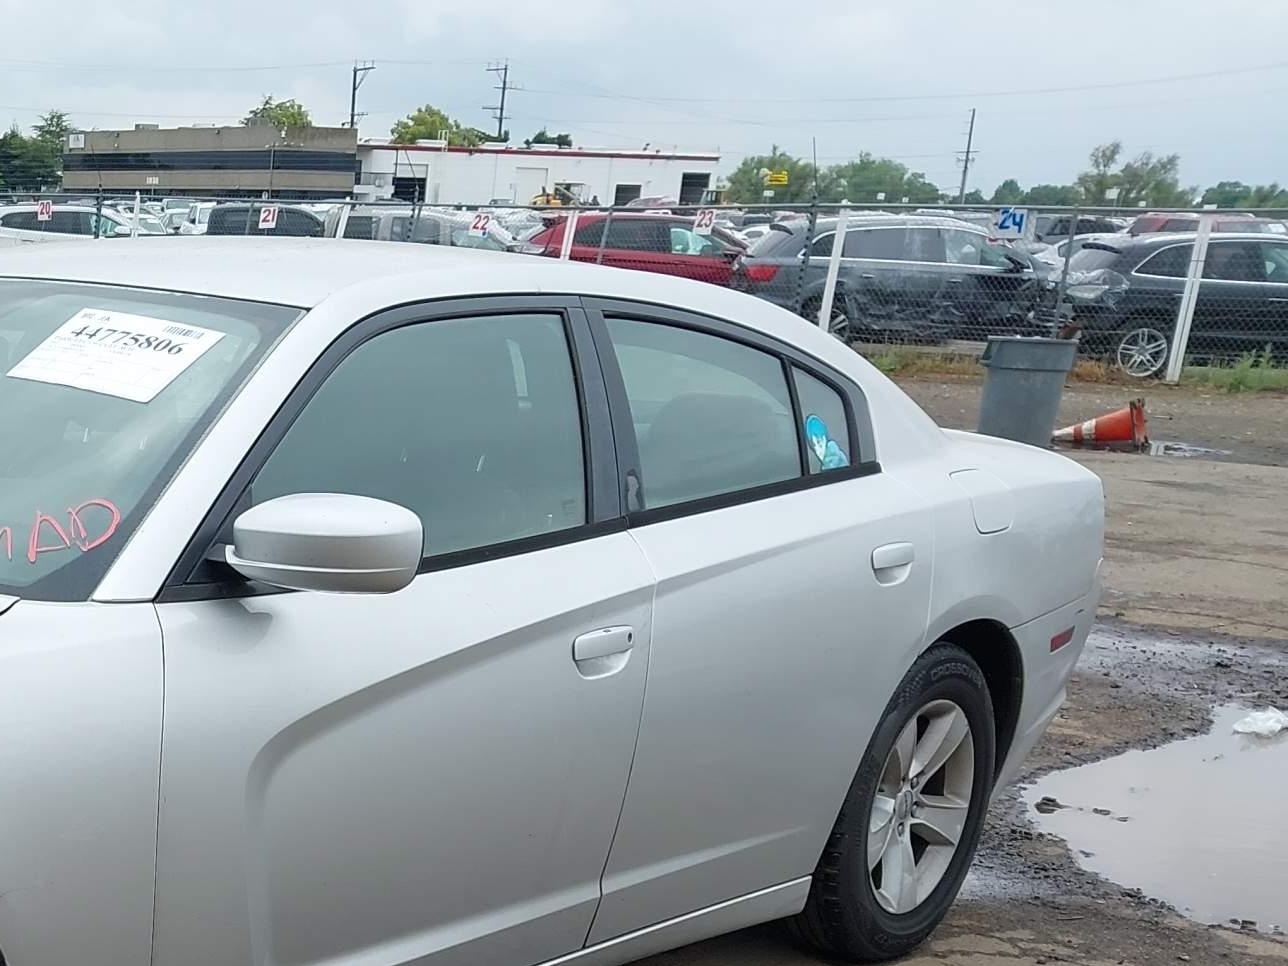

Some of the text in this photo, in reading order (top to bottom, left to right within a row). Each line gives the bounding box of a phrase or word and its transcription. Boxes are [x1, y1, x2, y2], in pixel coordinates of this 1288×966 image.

[39, 201, 51, 216] 20
[261, 208, 277, 223] 21
[472, 214, 490, 231] 22
[695, 210, 714, 228] 23
[998, 208, 1025, 234] 24
[71, 324, 188, 355] 44775806
